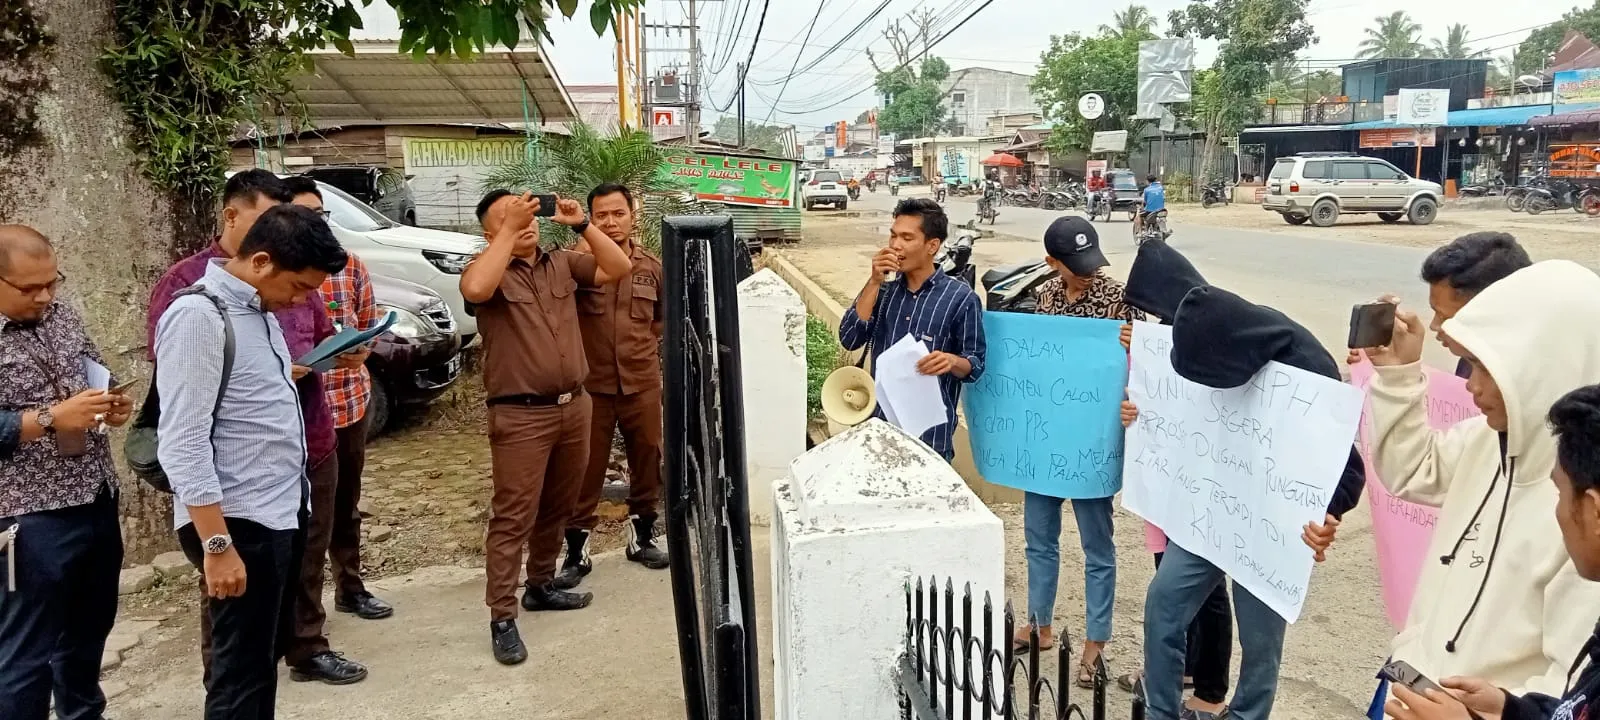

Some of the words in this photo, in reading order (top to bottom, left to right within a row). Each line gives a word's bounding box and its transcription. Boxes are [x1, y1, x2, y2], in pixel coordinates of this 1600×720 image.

[410, 140, 469, 167] AHMAD
[723, 160, 783, 172] LELE
[1002, 337, 1065, 361] DALAM
[1050, 378, 1101, 406] CALON
[1244, 367, 1320, 417] APH
[984, 406, 1015, 433] dan
[1204, 389, 1273, 449] SEGERA
[1192, 431, 1254, 476] DUGAAN
[1263, 456, 1327, 509] PUNGUTAN
[1260, 518, 1286, 547] DI
[1233, 532, 1265, 577] PADANG
[1265, 569, 1304, 607] LAWAS
